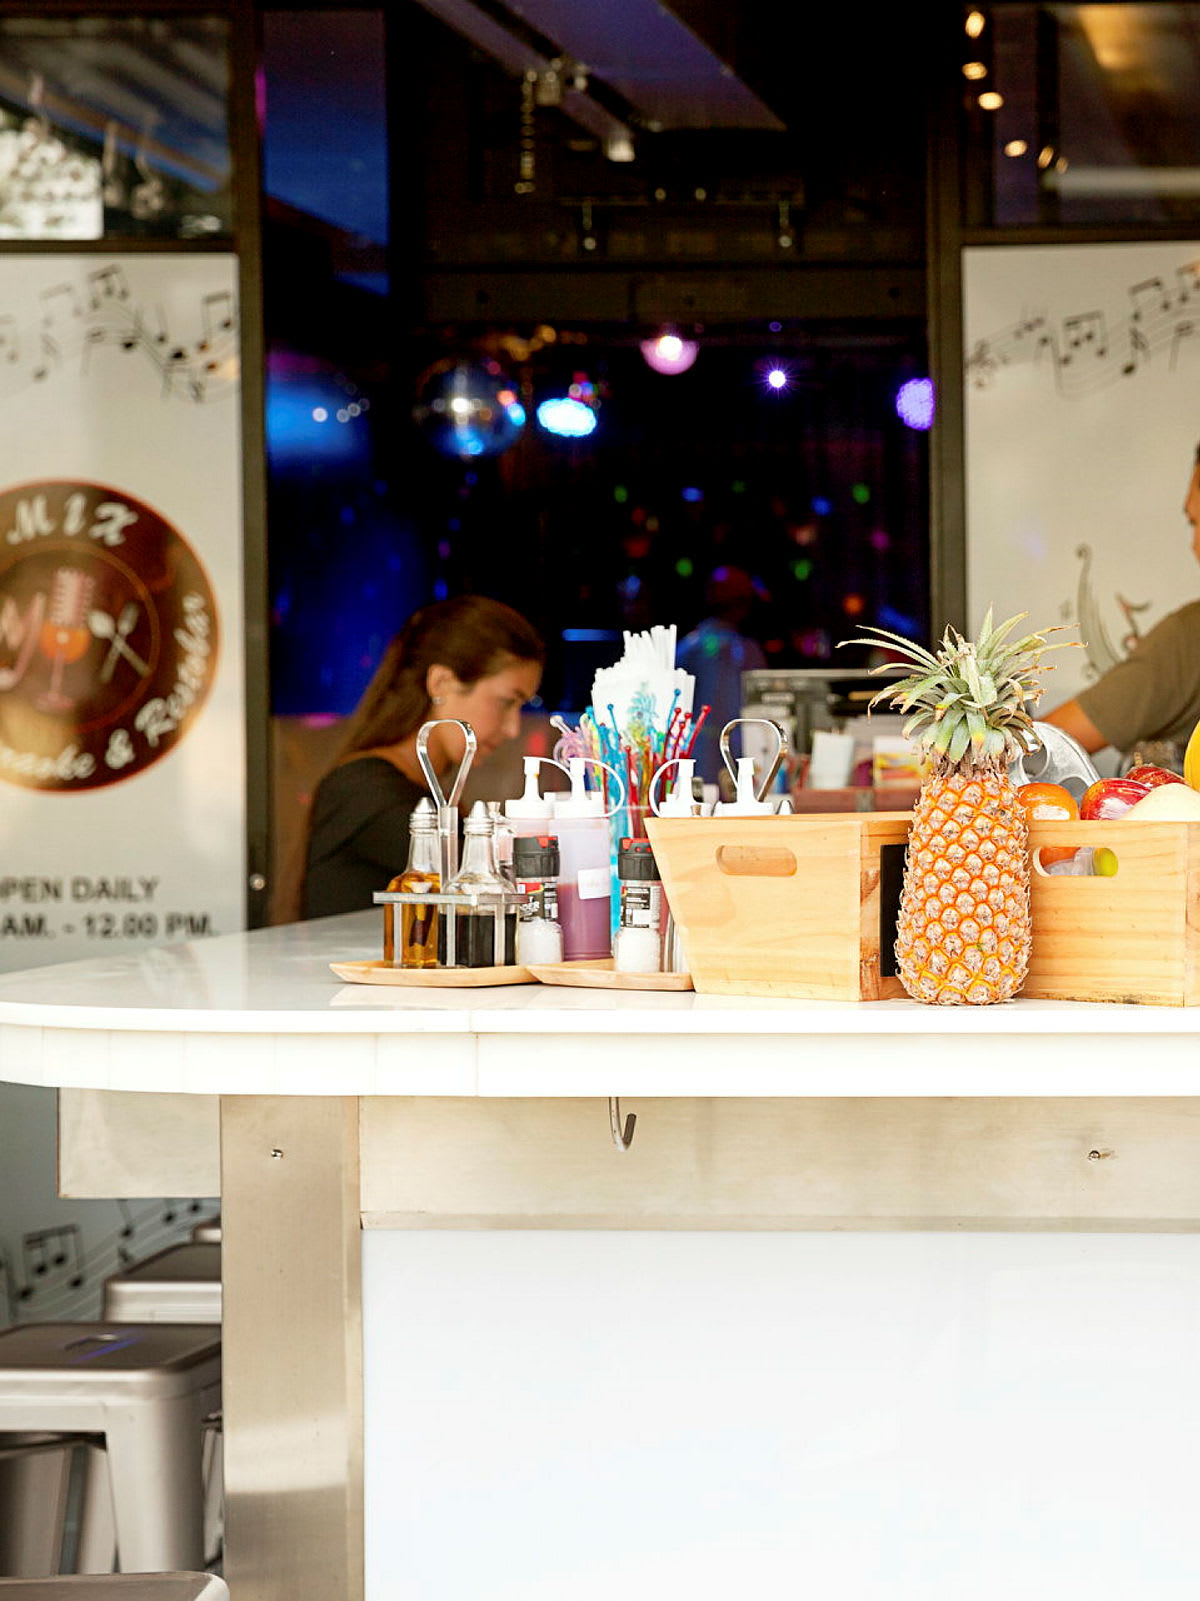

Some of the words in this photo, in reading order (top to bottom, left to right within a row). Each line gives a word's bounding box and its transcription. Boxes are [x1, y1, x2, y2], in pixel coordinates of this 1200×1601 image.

[6, 492, 139, 546] MIX
[105, 728, 136, 770] &
[71, 876, 160, 903] DAILY
